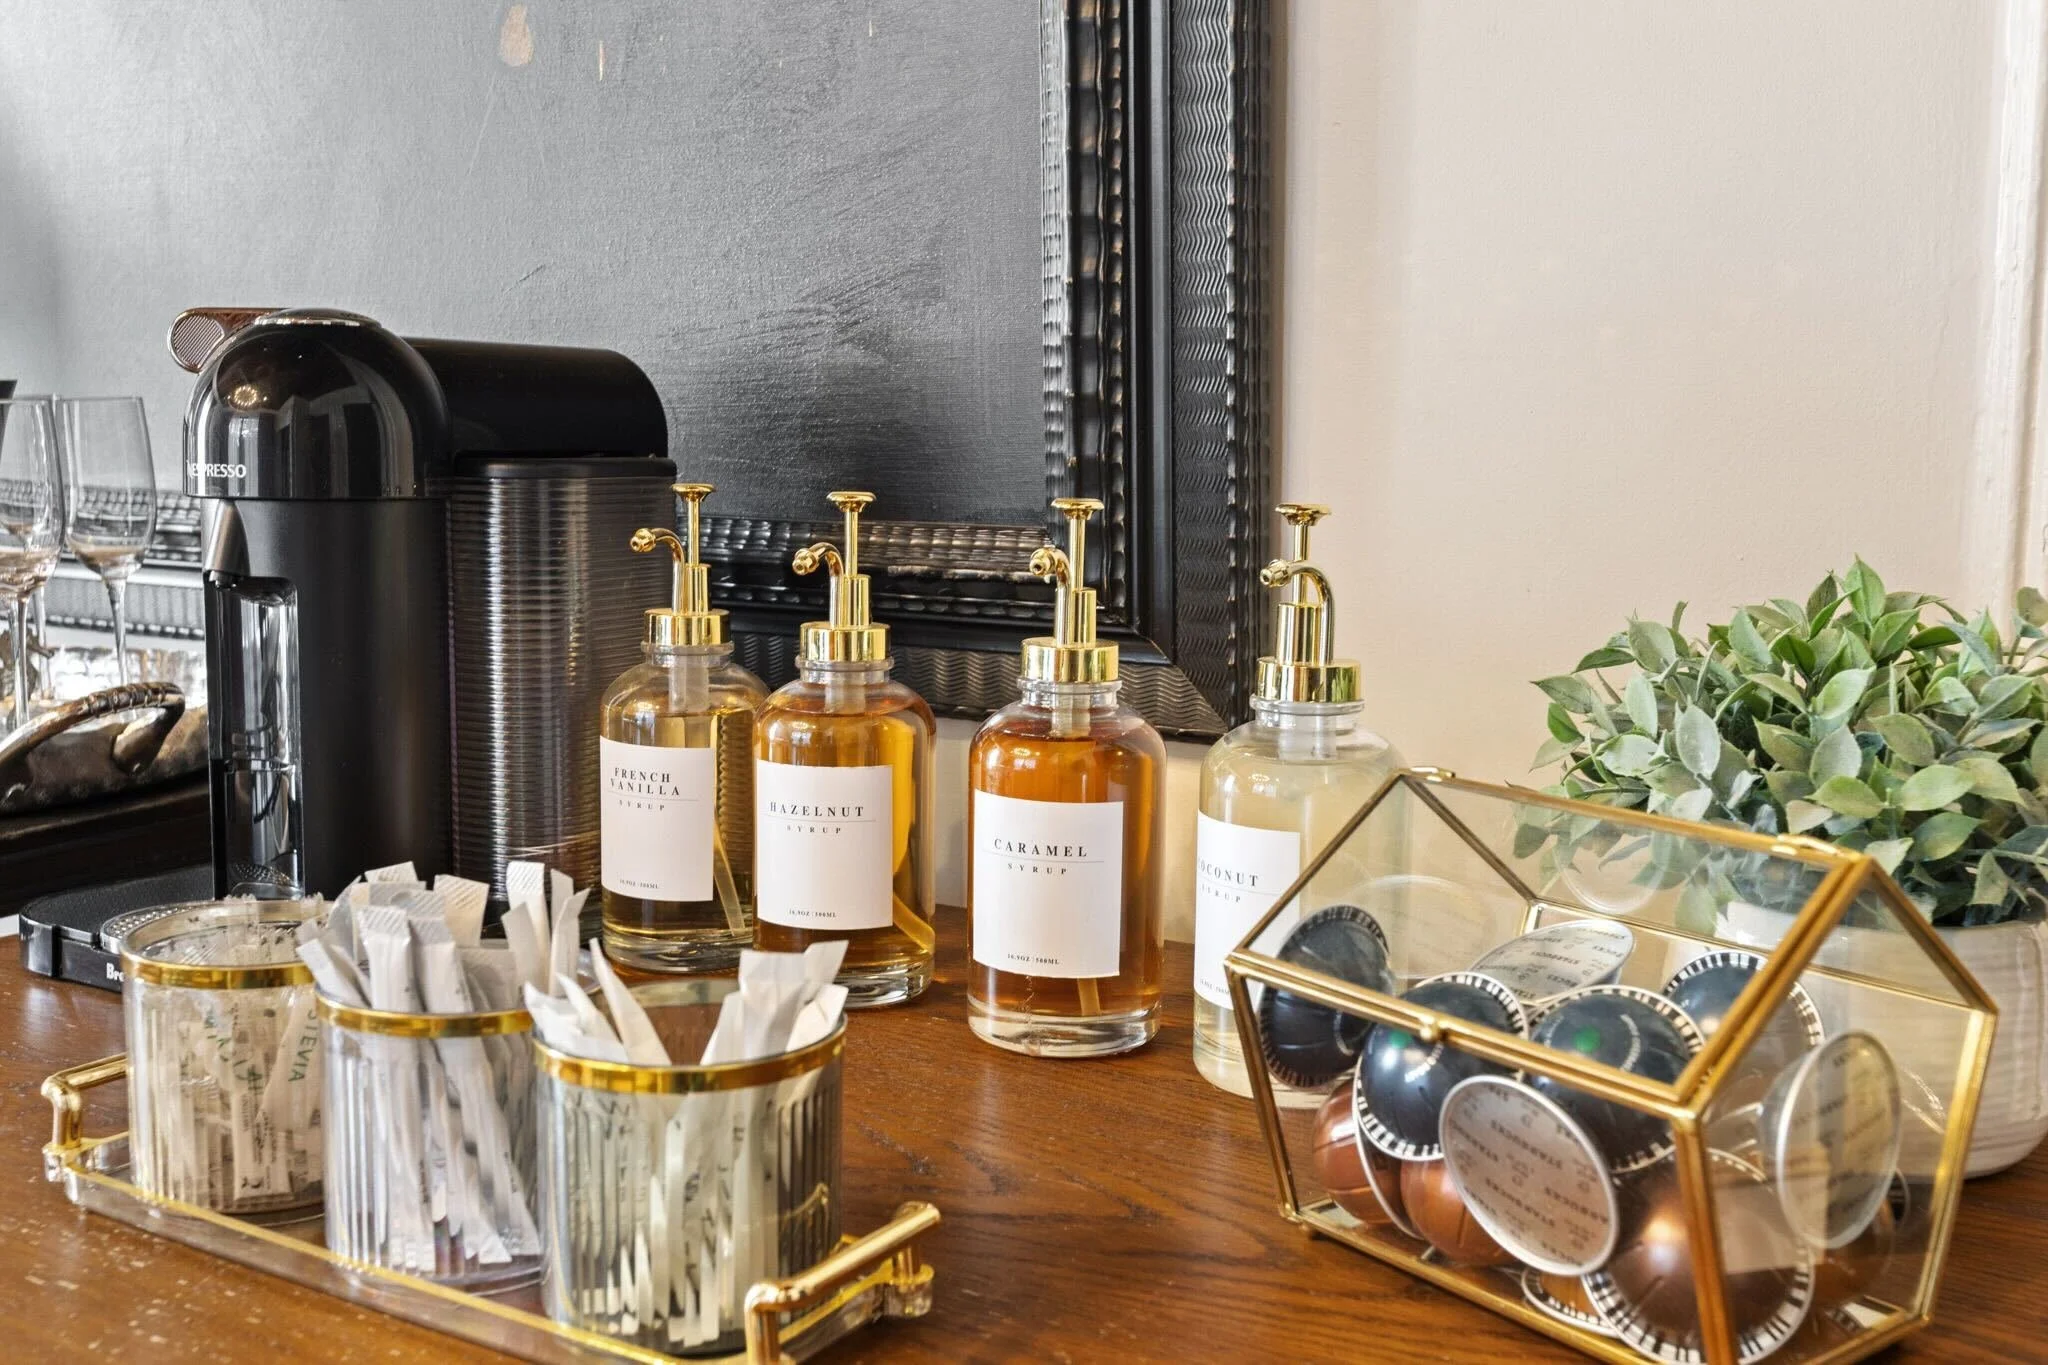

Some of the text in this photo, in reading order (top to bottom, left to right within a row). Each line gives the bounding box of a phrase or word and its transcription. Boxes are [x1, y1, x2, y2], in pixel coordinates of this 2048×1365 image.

[186, 459, 247, 479] NEPRESSO
[614, 767, 671, 784] FRENCH
[610, 777, 681, 797] VANILLA
[619, 799, 665, 812] SYRUP
[770, 801, 865, 818] HAZELNUT
[786, 824, 842, 835] SYRUP
[993, 838, 1089, 858] CARAMEL
[1007, 862, 1068, 876] SYRUP
